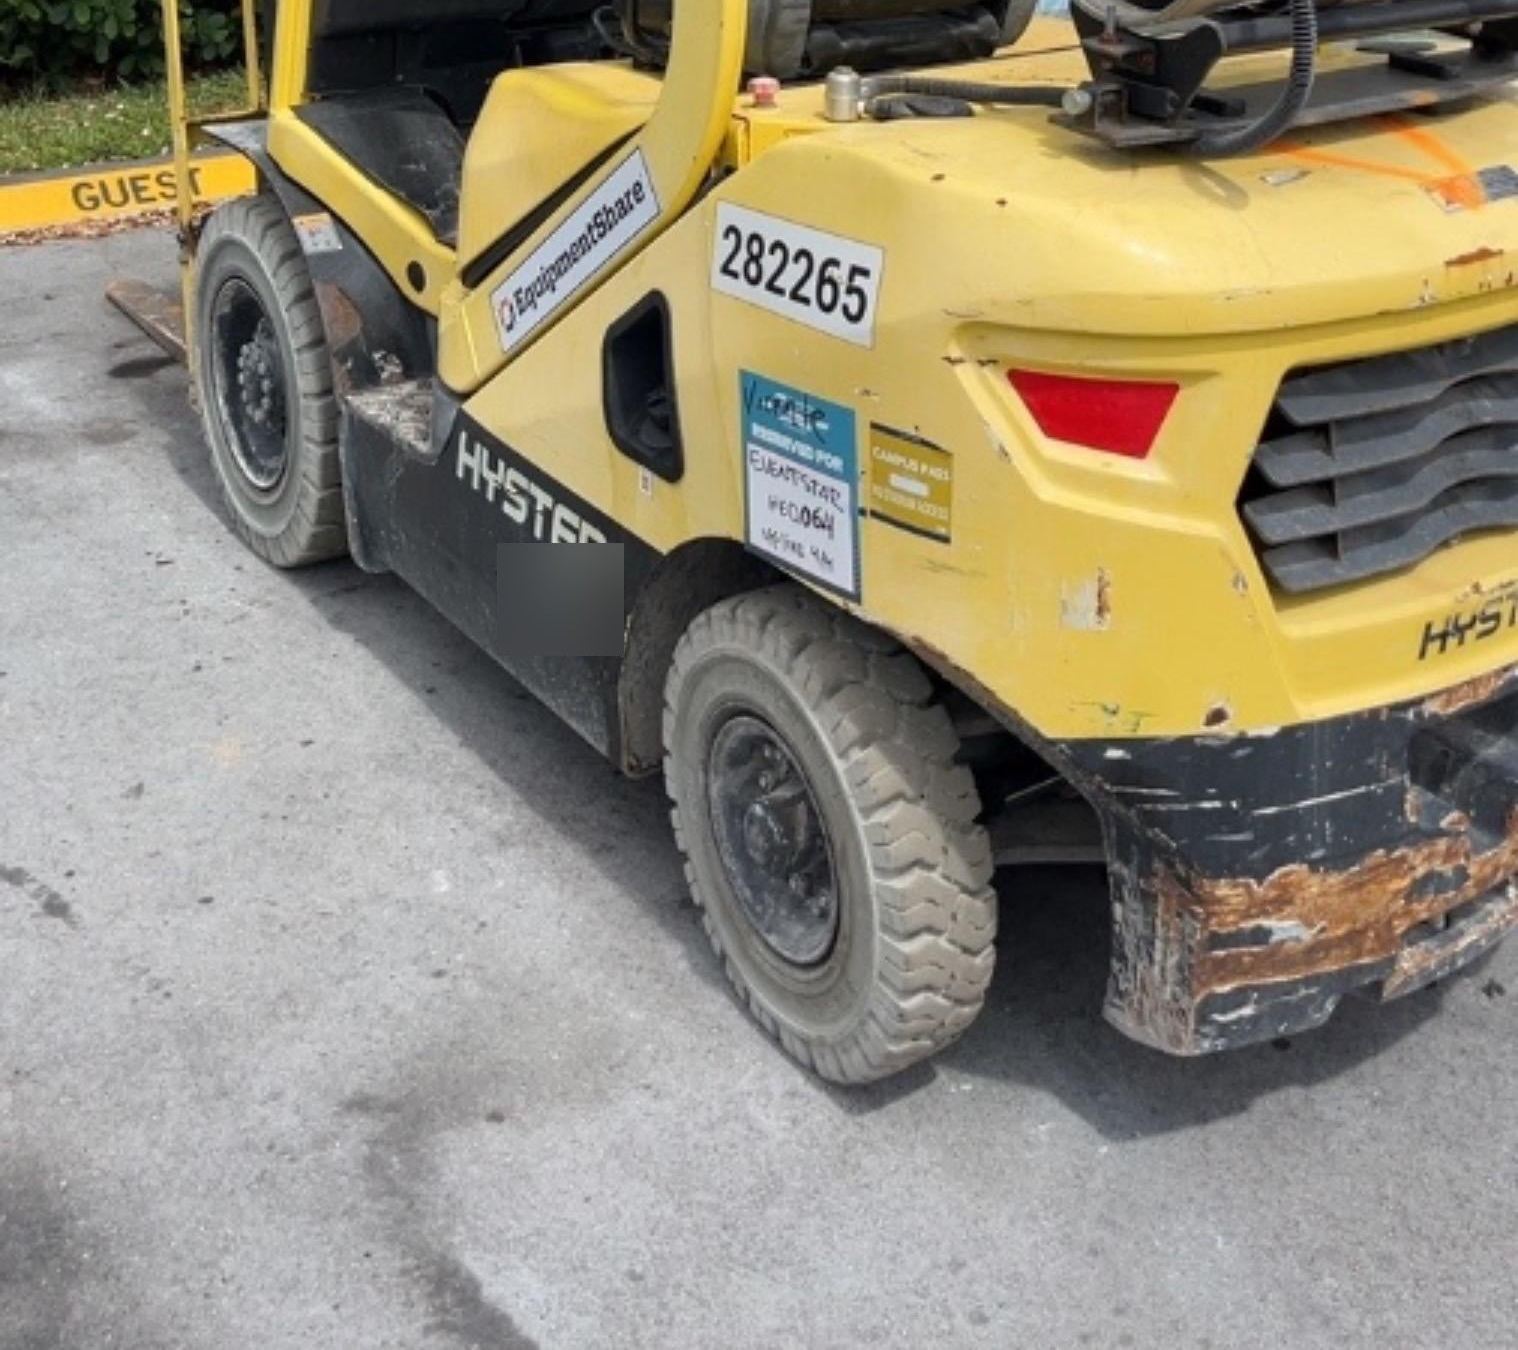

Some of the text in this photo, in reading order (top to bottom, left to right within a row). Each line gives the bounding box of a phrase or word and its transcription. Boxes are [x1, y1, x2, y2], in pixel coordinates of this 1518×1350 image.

[72, 167, 202, 211] GUEST
[513, 179, 646, 314] EquipmentShare
[720, 224, 871, 324] 282265
